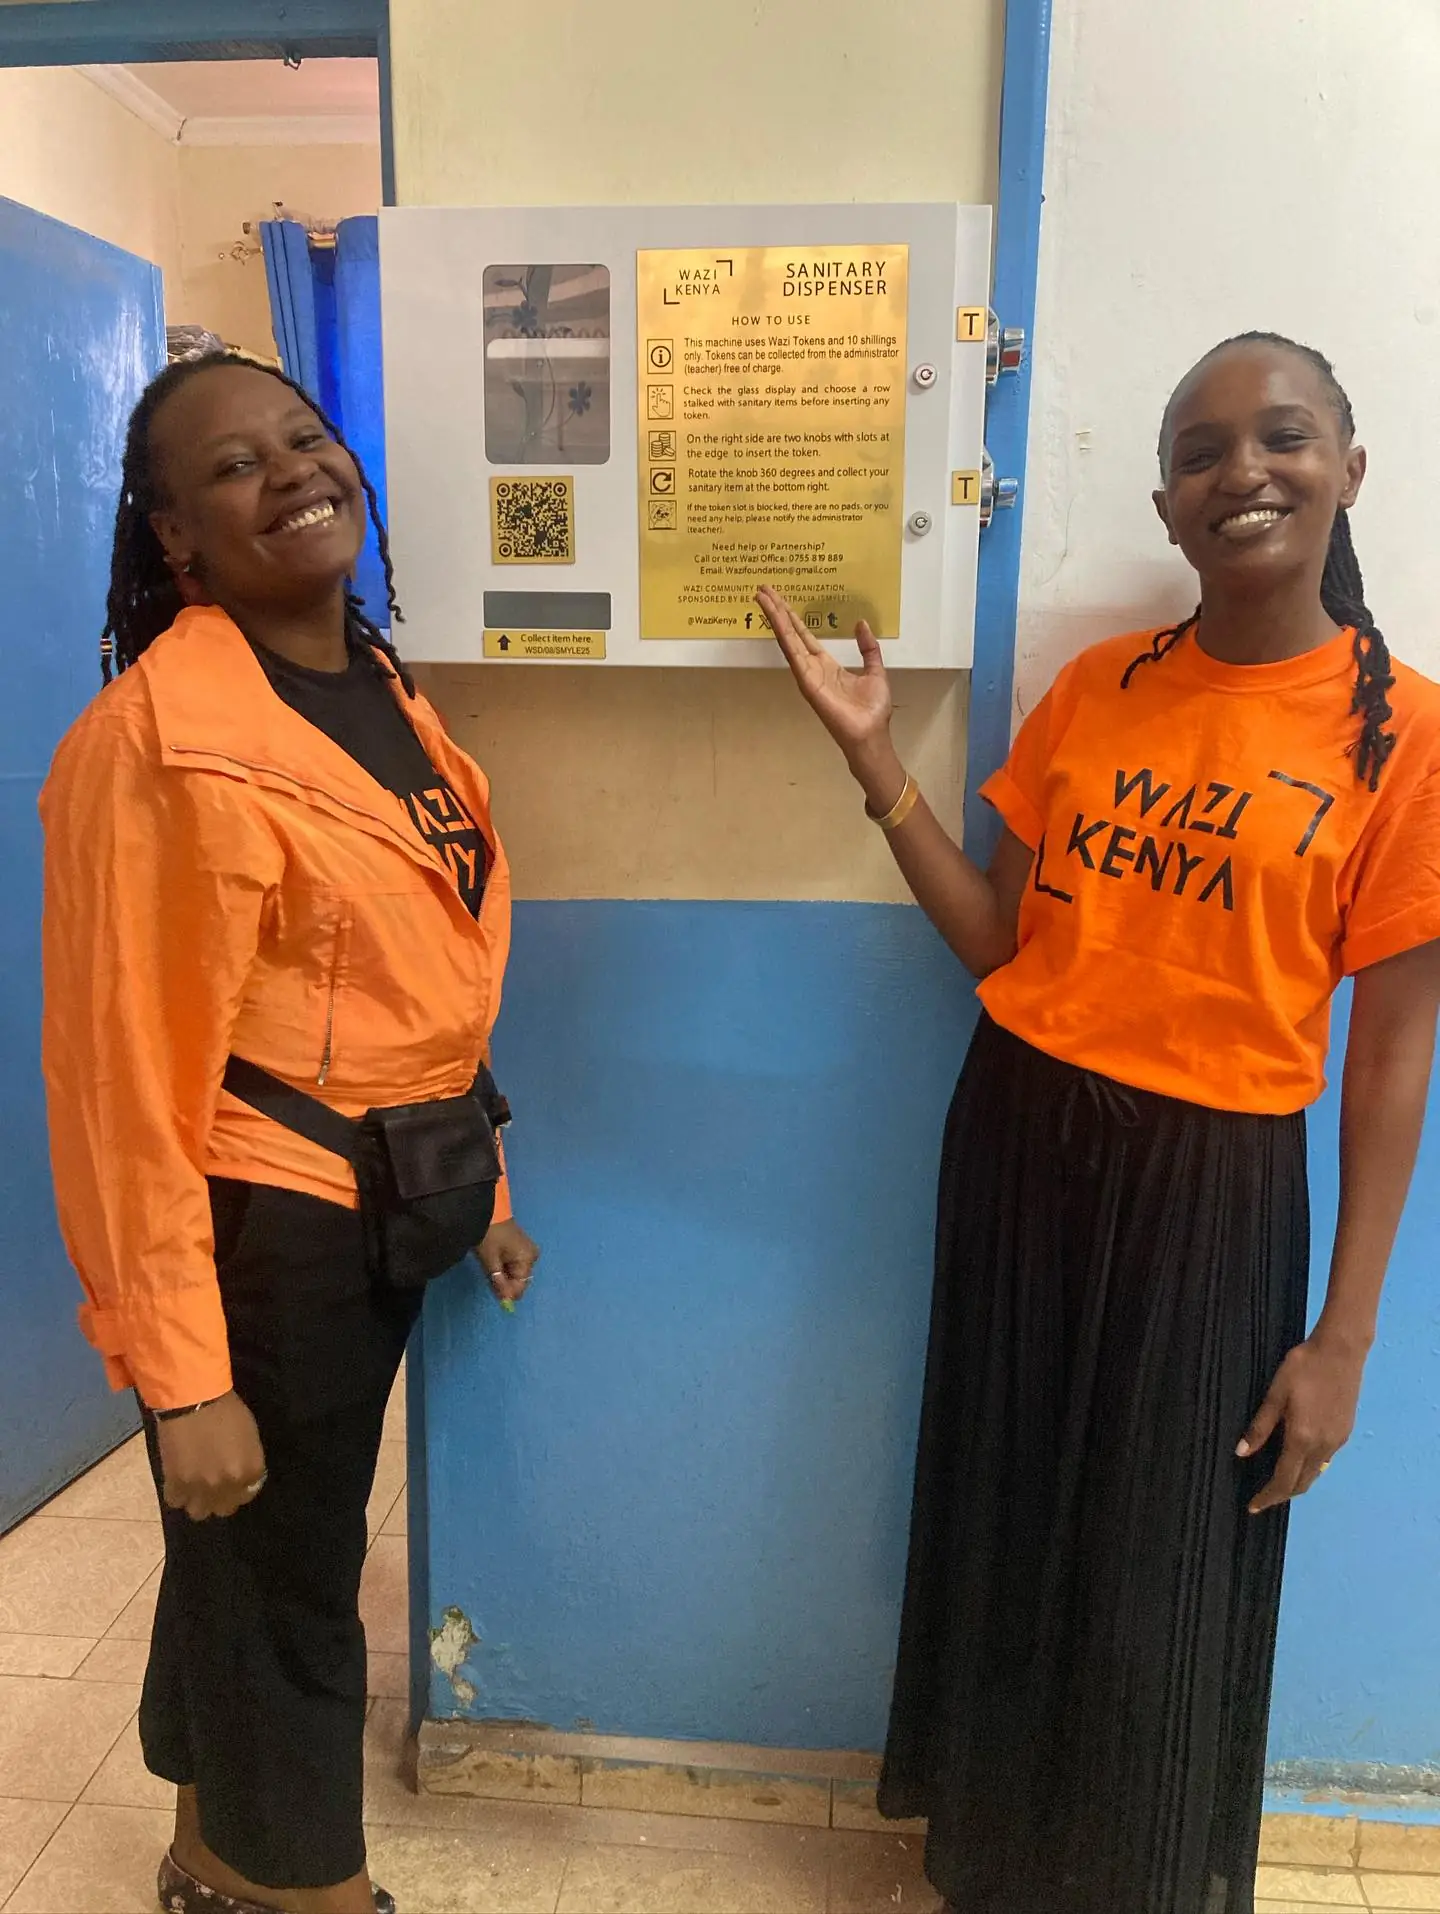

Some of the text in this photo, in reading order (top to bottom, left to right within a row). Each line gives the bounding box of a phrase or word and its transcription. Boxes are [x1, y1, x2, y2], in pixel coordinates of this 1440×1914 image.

[679, 269, 717, 280] WAZI
[786, 261, 886, 278] SANITARY
[676, 284, 720, 295] KENYA
[783, 280, 886, 297] DISPENSER
[732, 315, 811, 325] HOW TO USE
[964, 313, 979, 335] T
[684, 335, 897, 348] This machine uses Wazi Tokens and 10 shillings
[684, 351, 703, 362] only.
[706, 350, 735, 360] Tokens
[756, 350, 765, 359] be
[768, 350, 804, 359] collected
[807, 349, 826, 358] from
[829, 349, 841, 358] the
[844, 349, 899, 358] administrator
[684, 364, 783, 375] (teacher) free of charge.
[684, 386, 711, 395] Check
[718, 386, 731, 394] the
[738, 385, 759, 396] glass
[766, 384, 795, 395] display
[802, 384, 818, 393] and
[824, 384, 856, 393] choose
[863, 385, 867, 393] a
[684, 397, 889, 408] stalked with sanitary items before inserting any
[684, 411, 710, 420] token.
[687, 432, 889, 444] On the right side are two knobs with slots at
[687, 447, 820, 459] the edge to insert the token.
[688, 467, 889, 479] Rotate the knob 360 degrees and collect your
[689, 482, 829, 493] sanitary item at the bottom right.
[958, 477, 973, 499] T
[687, 503, 692, 511] If
[694, 503, 707, 511] the
[709, 503, 731, 511] token
[733, 503, 747, 511] slot
[749, 503, 755, 511] is
[792, 502, 812, 511] there
[815, 503, 827, 511] are
[829, 503, 840, 511] no
[874, 503, 889, 512] you
[687, 515, 707, 523] need
[709, 516, 723, 524] any
[746, 514, 771, 524] please
[773, 514, 795, 524] notify
[797, 514, 810, 522] the
[812, 514, 863, 522] administrator
[712, 543, 825, 552] Need help or Partnership?
[694, 555, 710, 563] Call
[712, 555, 721, 563] or
[722, 555, 738, 563] text
[739, 554, 759, 563] Wazi
[788, 554, 809, 562] 0755
[827, 553, 844, 562] 889
[683, 585, 703, 593] WAZI
[784, 584, 845, 592] ORGANIZATION
[678, 595, 726, 603] SPONSORED
[727, 595, 738, 603] BY
[740, 595, 750, 603] BE
[779, 594, 815, 602] STRALIA
[687, 616, 737, 628] @WaziKenya
[521, 634, 592, 643] Collect item here.
[1115, 768, 1253, 839] WAZI
[400, 788, 476, 835] AZI
[1066, 813, 1233, 911] KENYA
